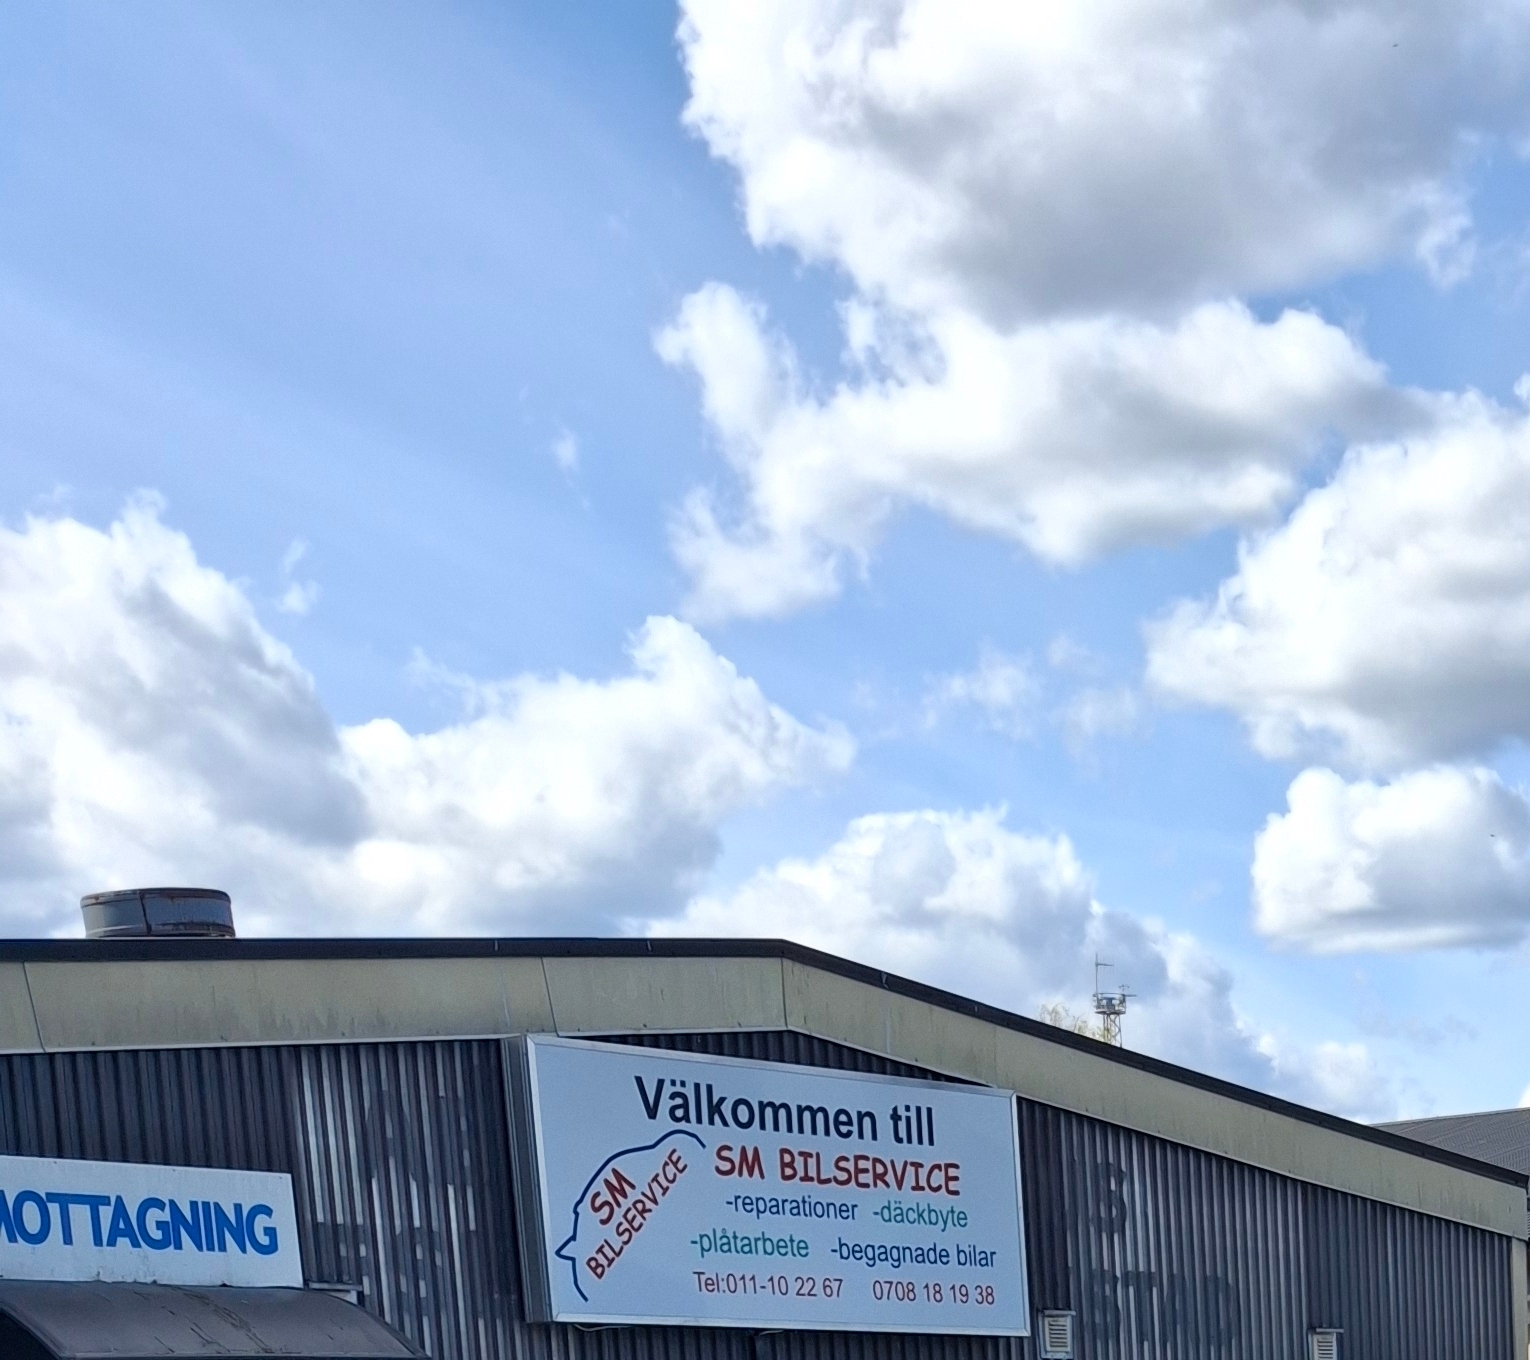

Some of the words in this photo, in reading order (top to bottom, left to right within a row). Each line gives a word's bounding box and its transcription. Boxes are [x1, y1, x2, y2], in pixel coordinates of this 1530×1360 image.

[634, 1075, 878, 1141] Välkommen
[890, 1104, 935, 1147] till
[714, 1144, 765, 1180] SM
[778, 1147, 961, 1196] BILSERVICE
[585, 1147, 688, 1280] BILSERVICE
[589, 1167, 637, 1226] SM
[726, 1194, 859, 1221] -reparationer
[872, 1200, 968, 1232] -däckbyte
[690, 1227, 810, 1258] -plåtarbete
[830, 1237, 951, 1269] -begagnade
[955, 1243, 997, 1268] bilar
[692, 1271, 789, 1297] Tel:011-10
[794, 1275, 817, 1298] 22
[822, 1277, 844, 1299] 67
[872, 1280, 917, 1302] 0708
[922, 1282, 944, 1303] 18
[949, 1283, 970, 1305] 19
[974, 1285, 995, 1306] 38
